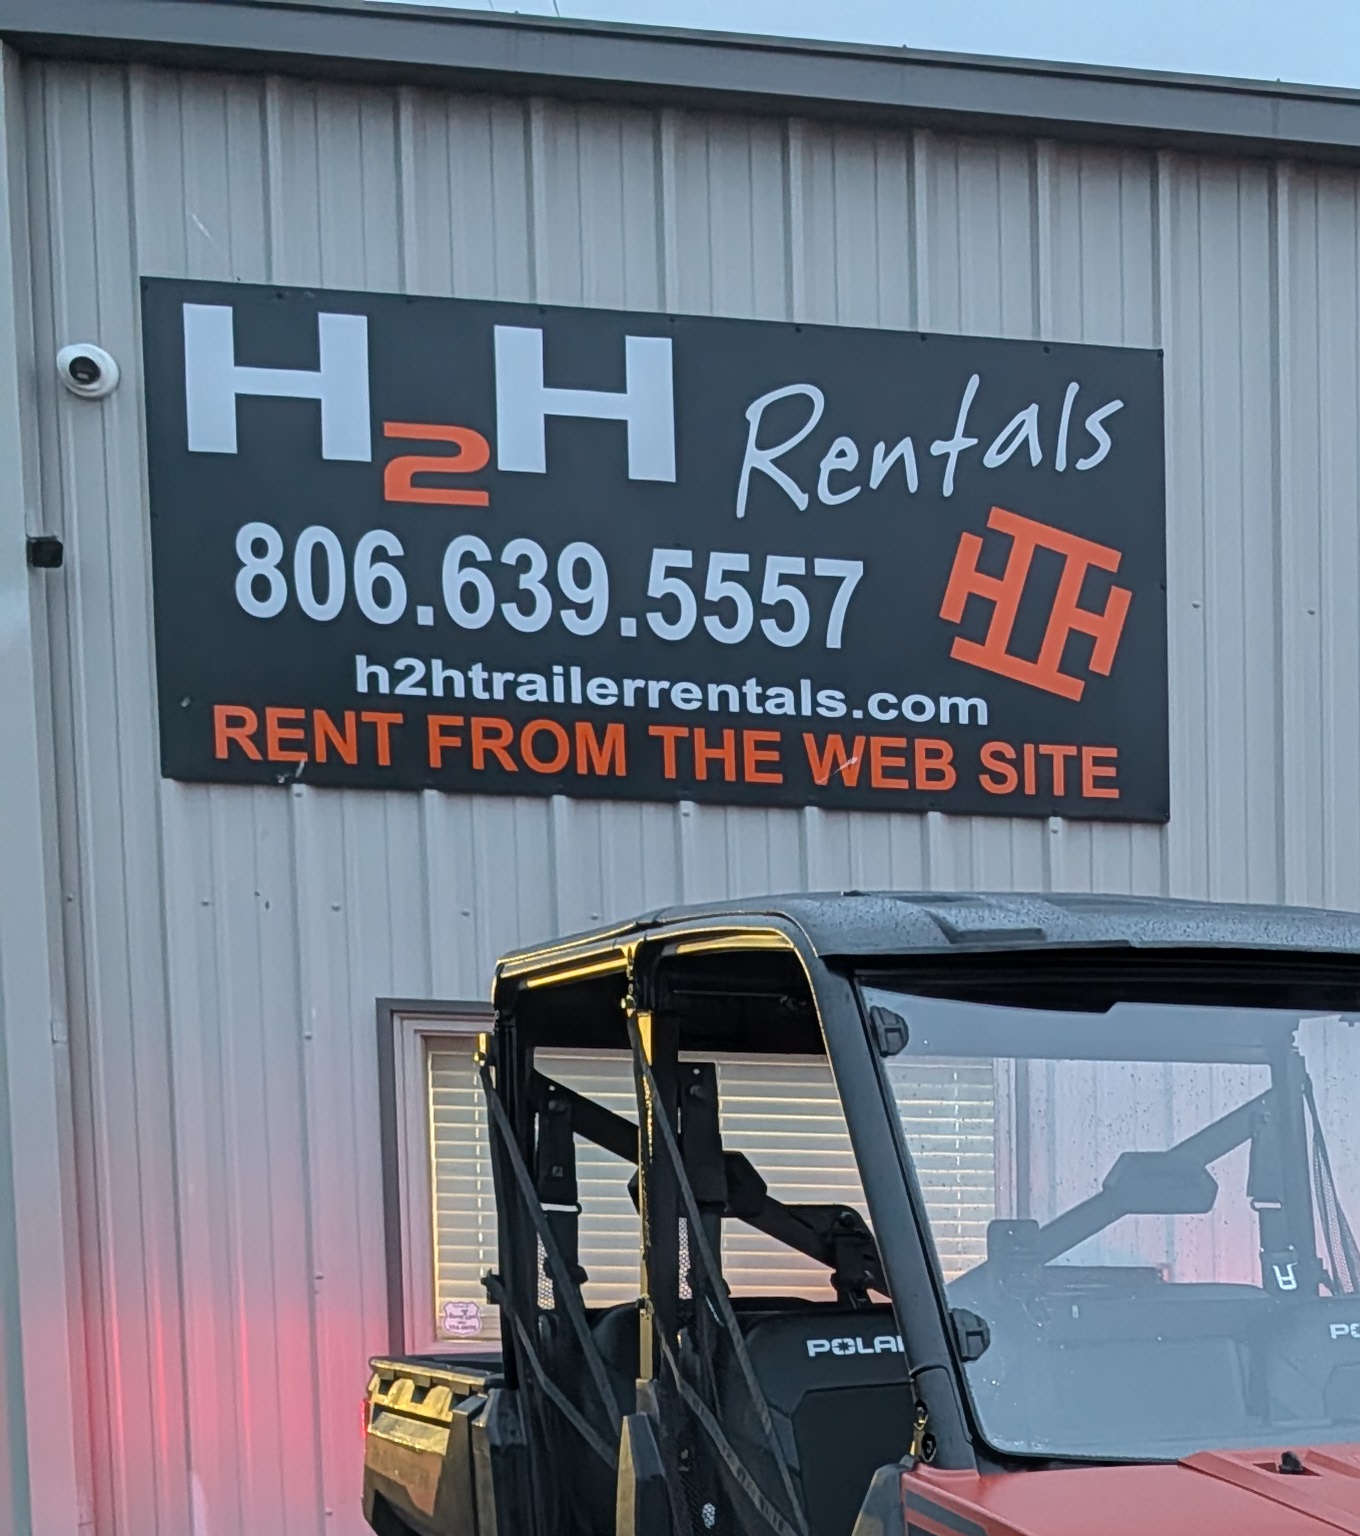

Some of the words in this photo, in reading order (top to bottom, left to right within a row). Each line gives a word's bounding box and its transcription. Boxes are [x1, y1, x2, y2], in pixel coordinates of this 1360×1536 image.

[182, 302, 677, 507] H2H
[736, 373, 1125, 519] Rentals
[234, 521, 864, 649] 806.639.5557
[355, 654, 989, 726] h2htrailerrentals.com
[213, 704, 404, 766] RENT
[427, 714, 627, 777] FROM
[648, 725, 783, 784] THE
[803, 732, 957, 791] WEB
[979, 741, 1119, 799] SITE
[806, 1335, 905, 1357] POLA
